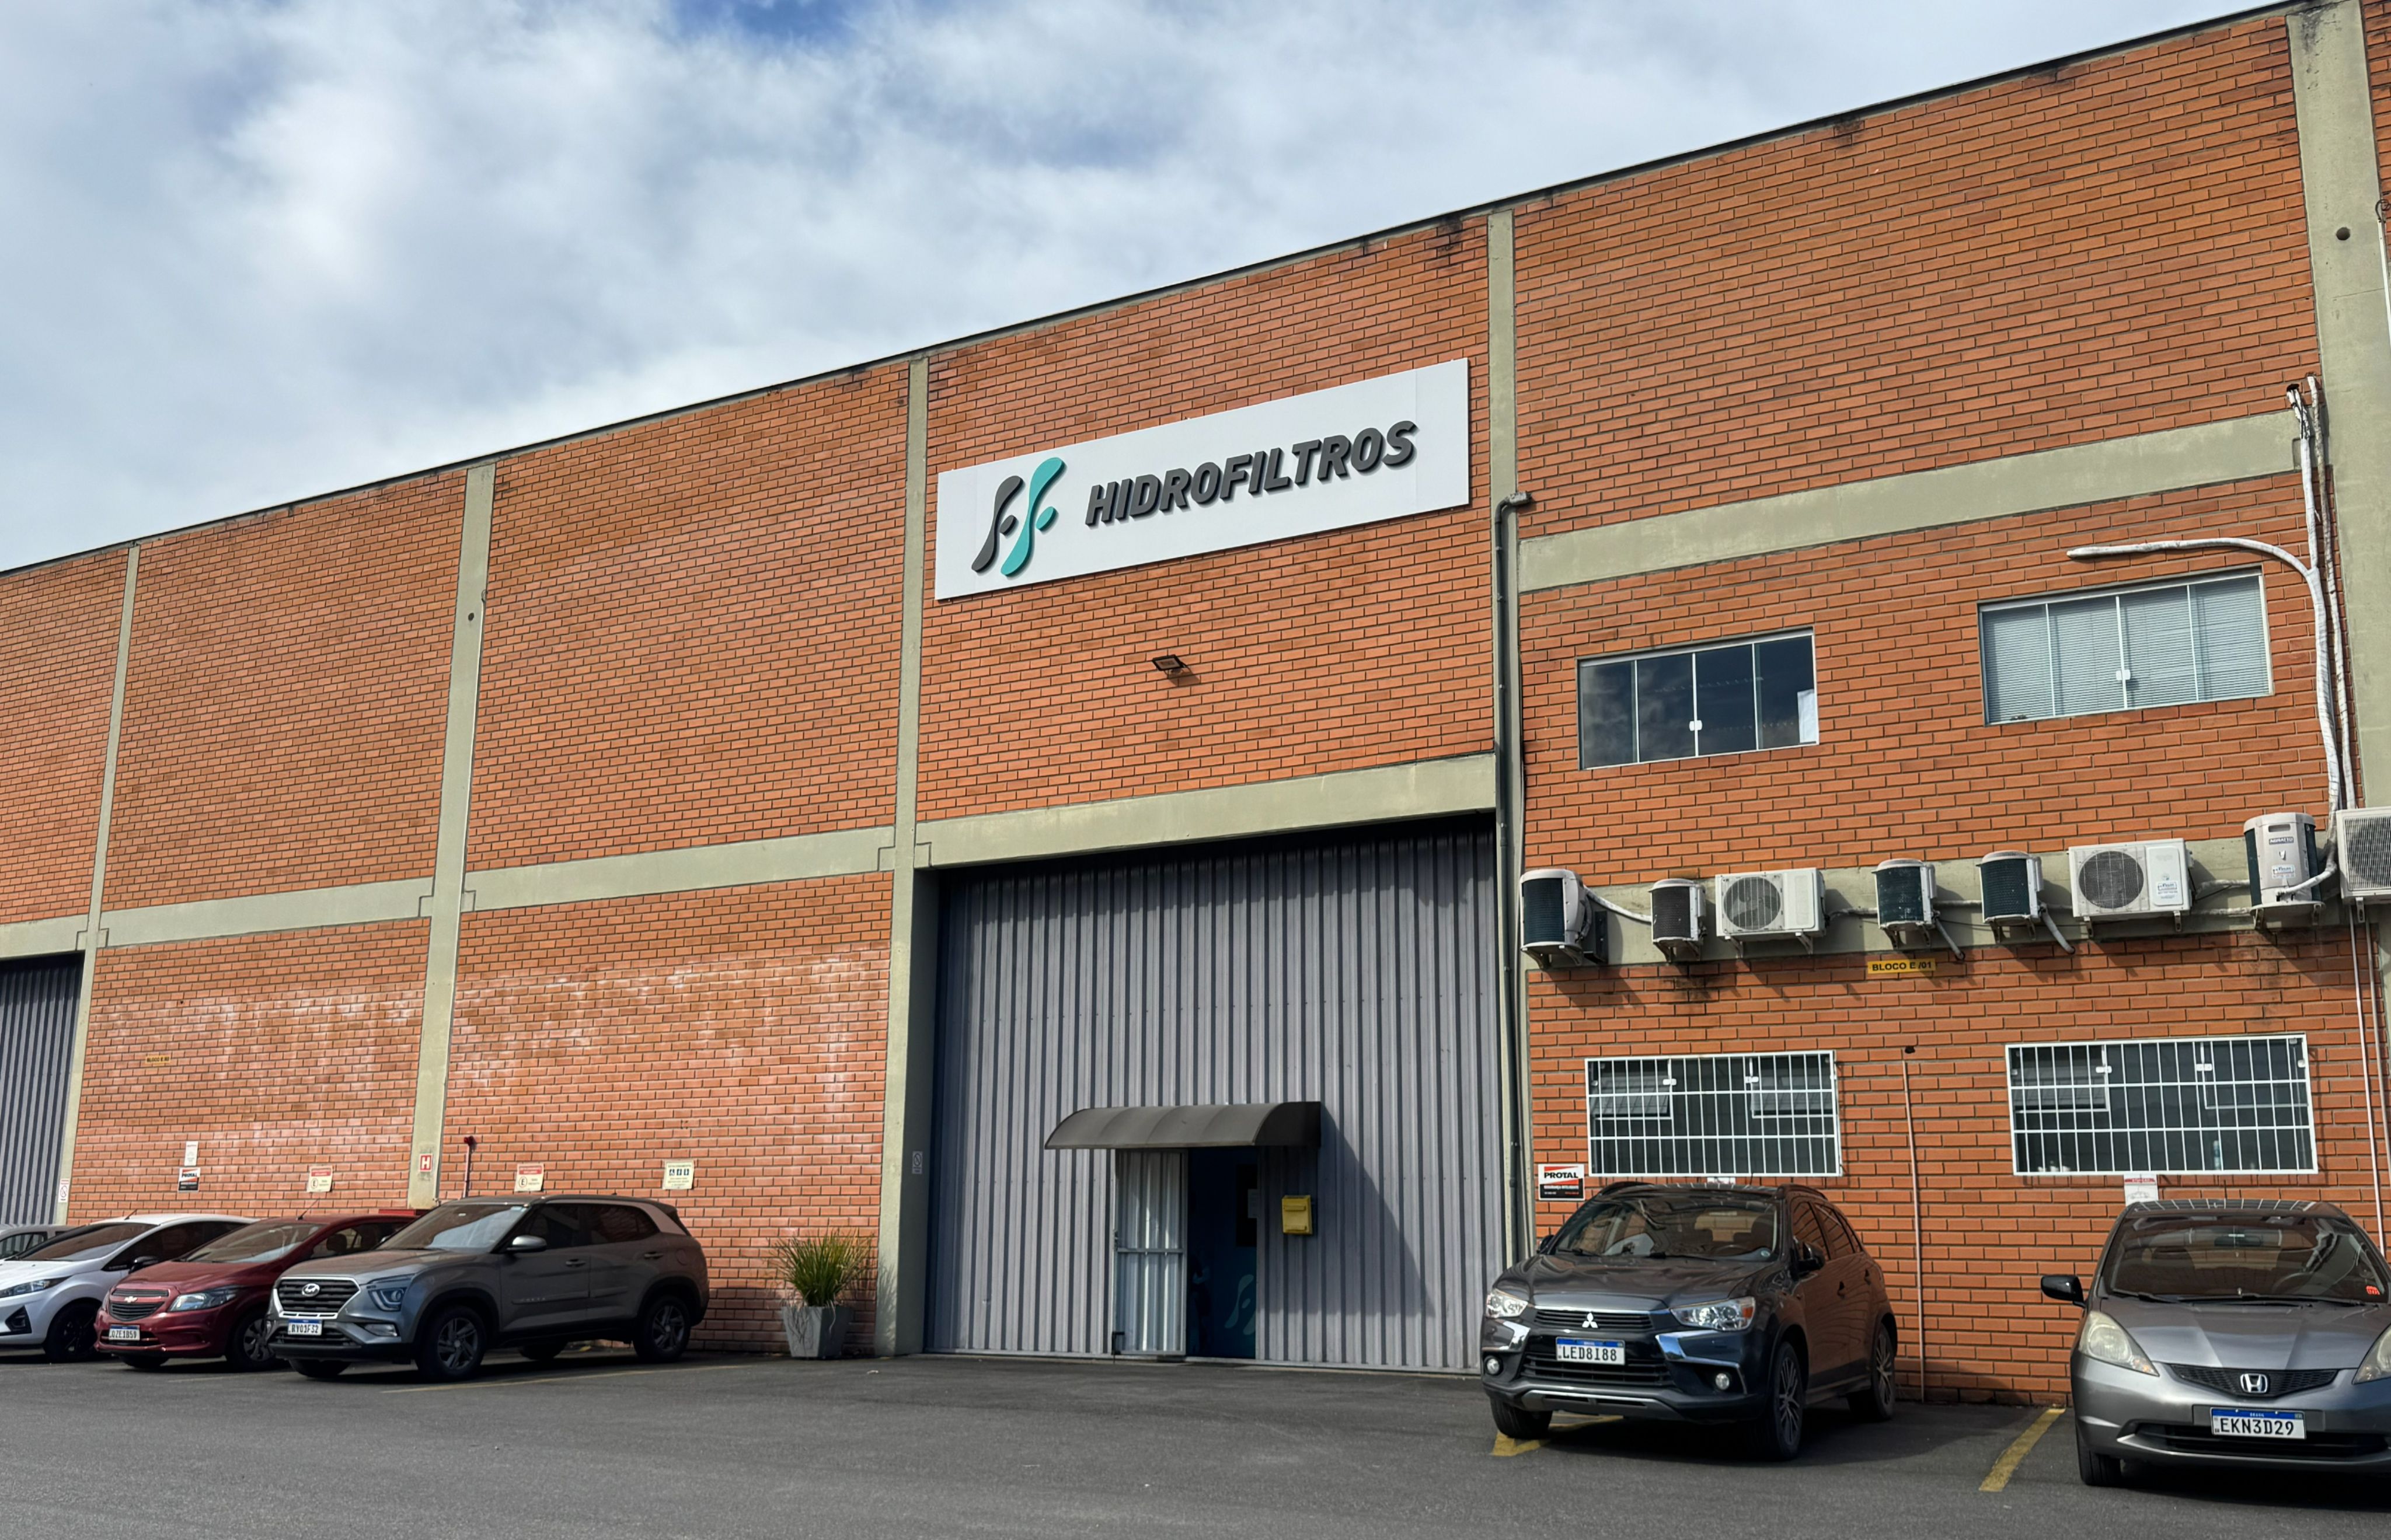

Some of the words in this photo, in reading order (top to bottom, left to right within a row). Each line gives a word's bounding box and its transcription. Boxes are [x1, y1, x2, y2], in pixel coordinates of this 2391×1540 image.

[1085, 420, 1418, 527] HIDROFILTROS
[1872, 962, 1907, 971] BLOCO
[421, 1156, 431, 1169] H
[1563, 1346, 1617, 1361] LED8I88
[2220, 1417, 2294, 1436] EKN3D29
